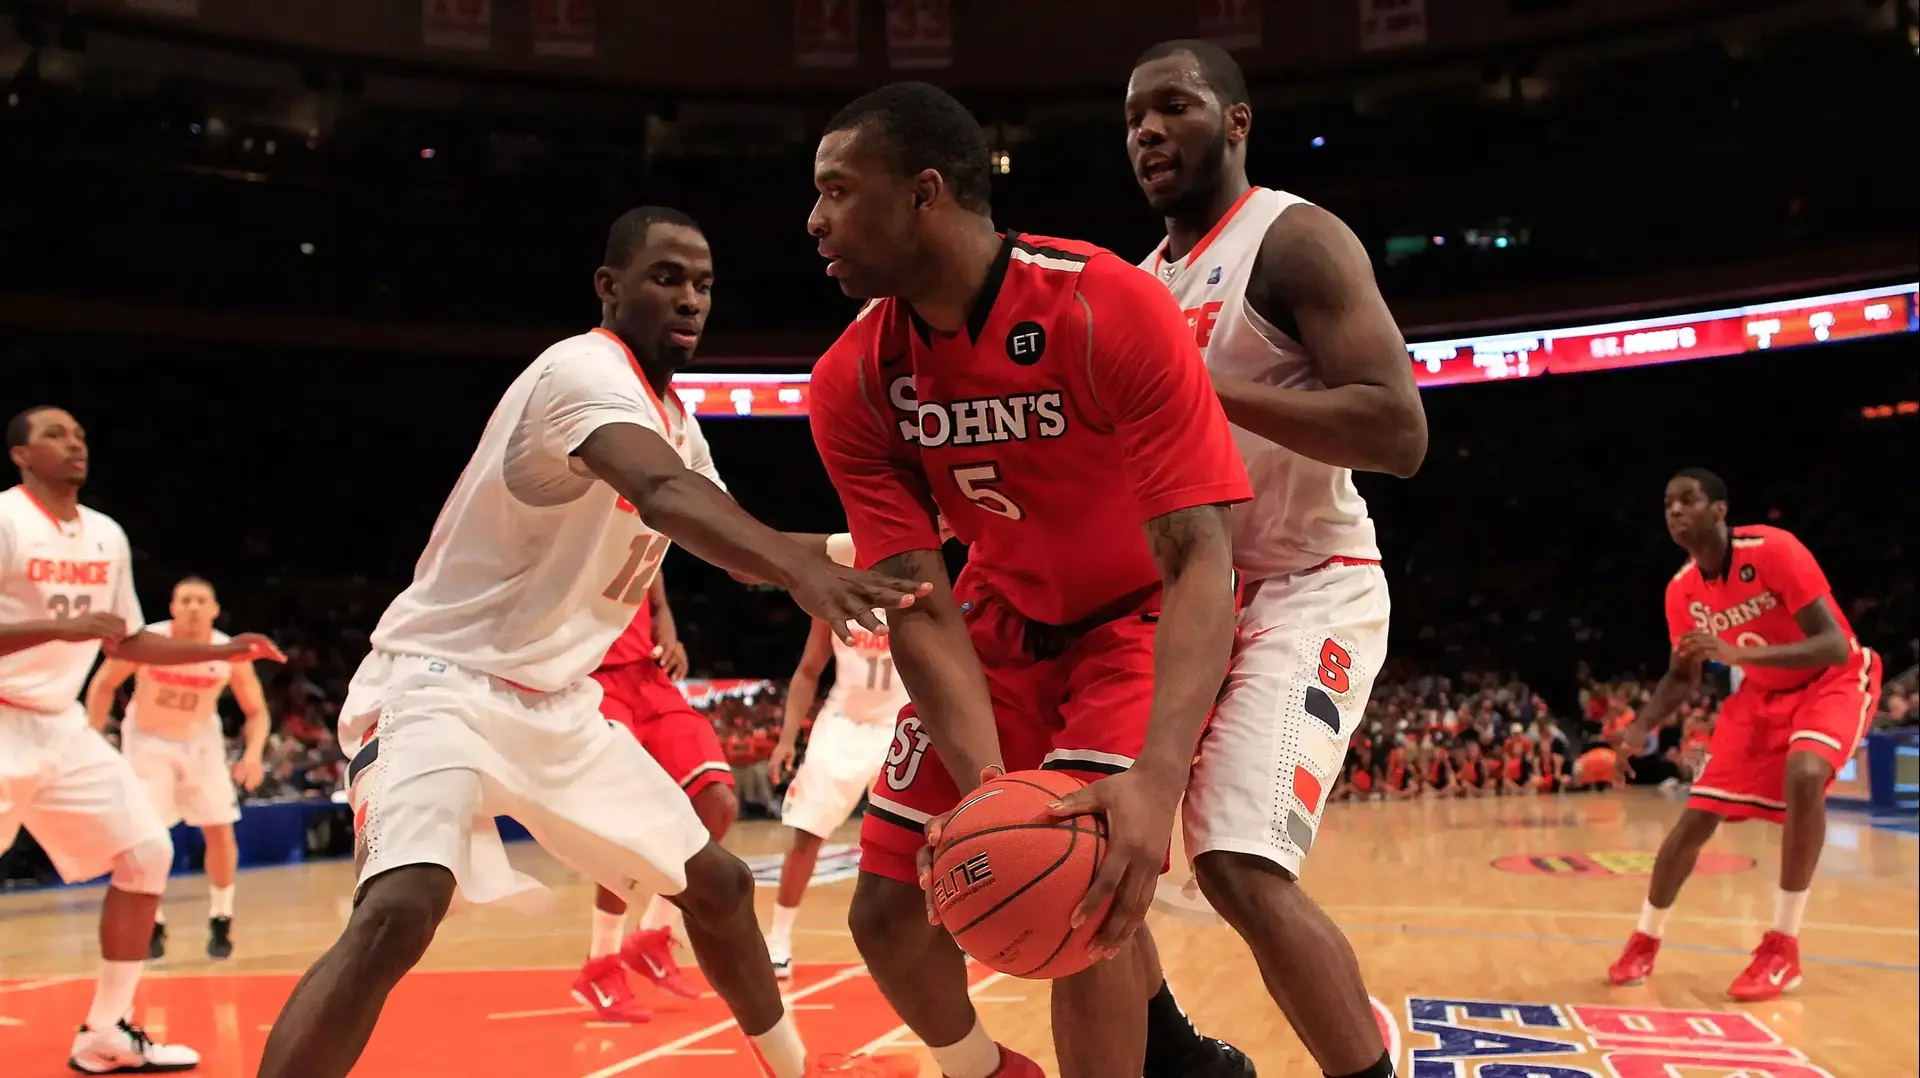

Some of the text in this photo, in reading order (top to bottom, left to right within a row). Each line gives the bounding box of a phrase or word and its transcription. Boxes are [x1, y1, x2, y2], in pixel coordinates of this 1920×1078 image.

[1012, 331, 1039, 356] ET
[952, 464, 1022, 520] 5
[27, 558, 109, 585] ORANGE
[866, 655, 892, 691] 11
[1318, 637, 1352, 694] S
[933, 851, 993, 909] ELITE
